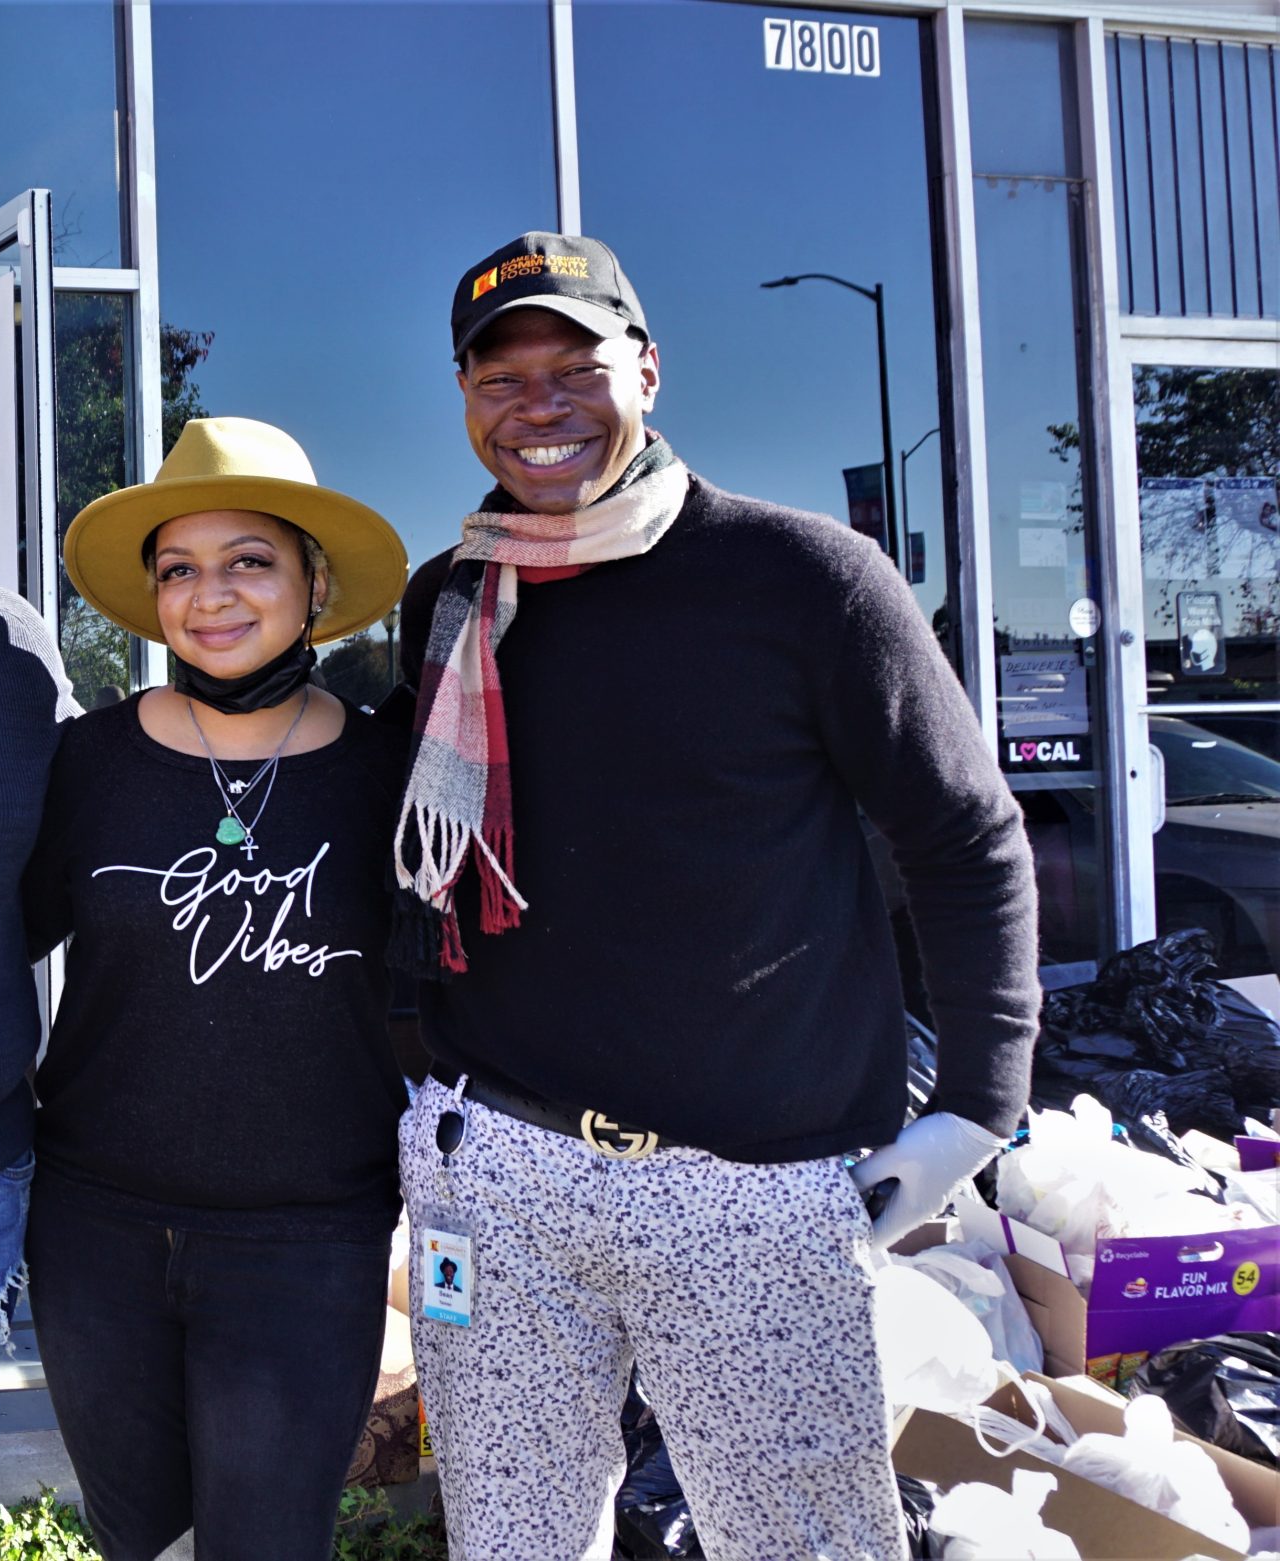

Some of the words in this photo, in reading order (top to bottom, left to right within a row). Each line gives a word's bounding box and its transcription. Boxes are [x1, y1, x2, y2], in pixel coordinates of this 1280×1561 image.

[768, 22, 876, 72] 7800
[501, 266, 542, 284] FOOD
[550, 265, 590, 279] BANK
[1005, 660, 1076, 673] DELIVERIES
[92, 842, 330, 931] Good
[189, 892, 362, 985] Vibes
[1115, 1251, 1150, 1261] Recyclable
[1182, 1272, 1208, 1285] FUN
[1236, 1269, 1256, 1286] 54
[1154, 1285, 1203, 1299] FLAVOR
[1205, 1281, 1228, 1295] MIX
